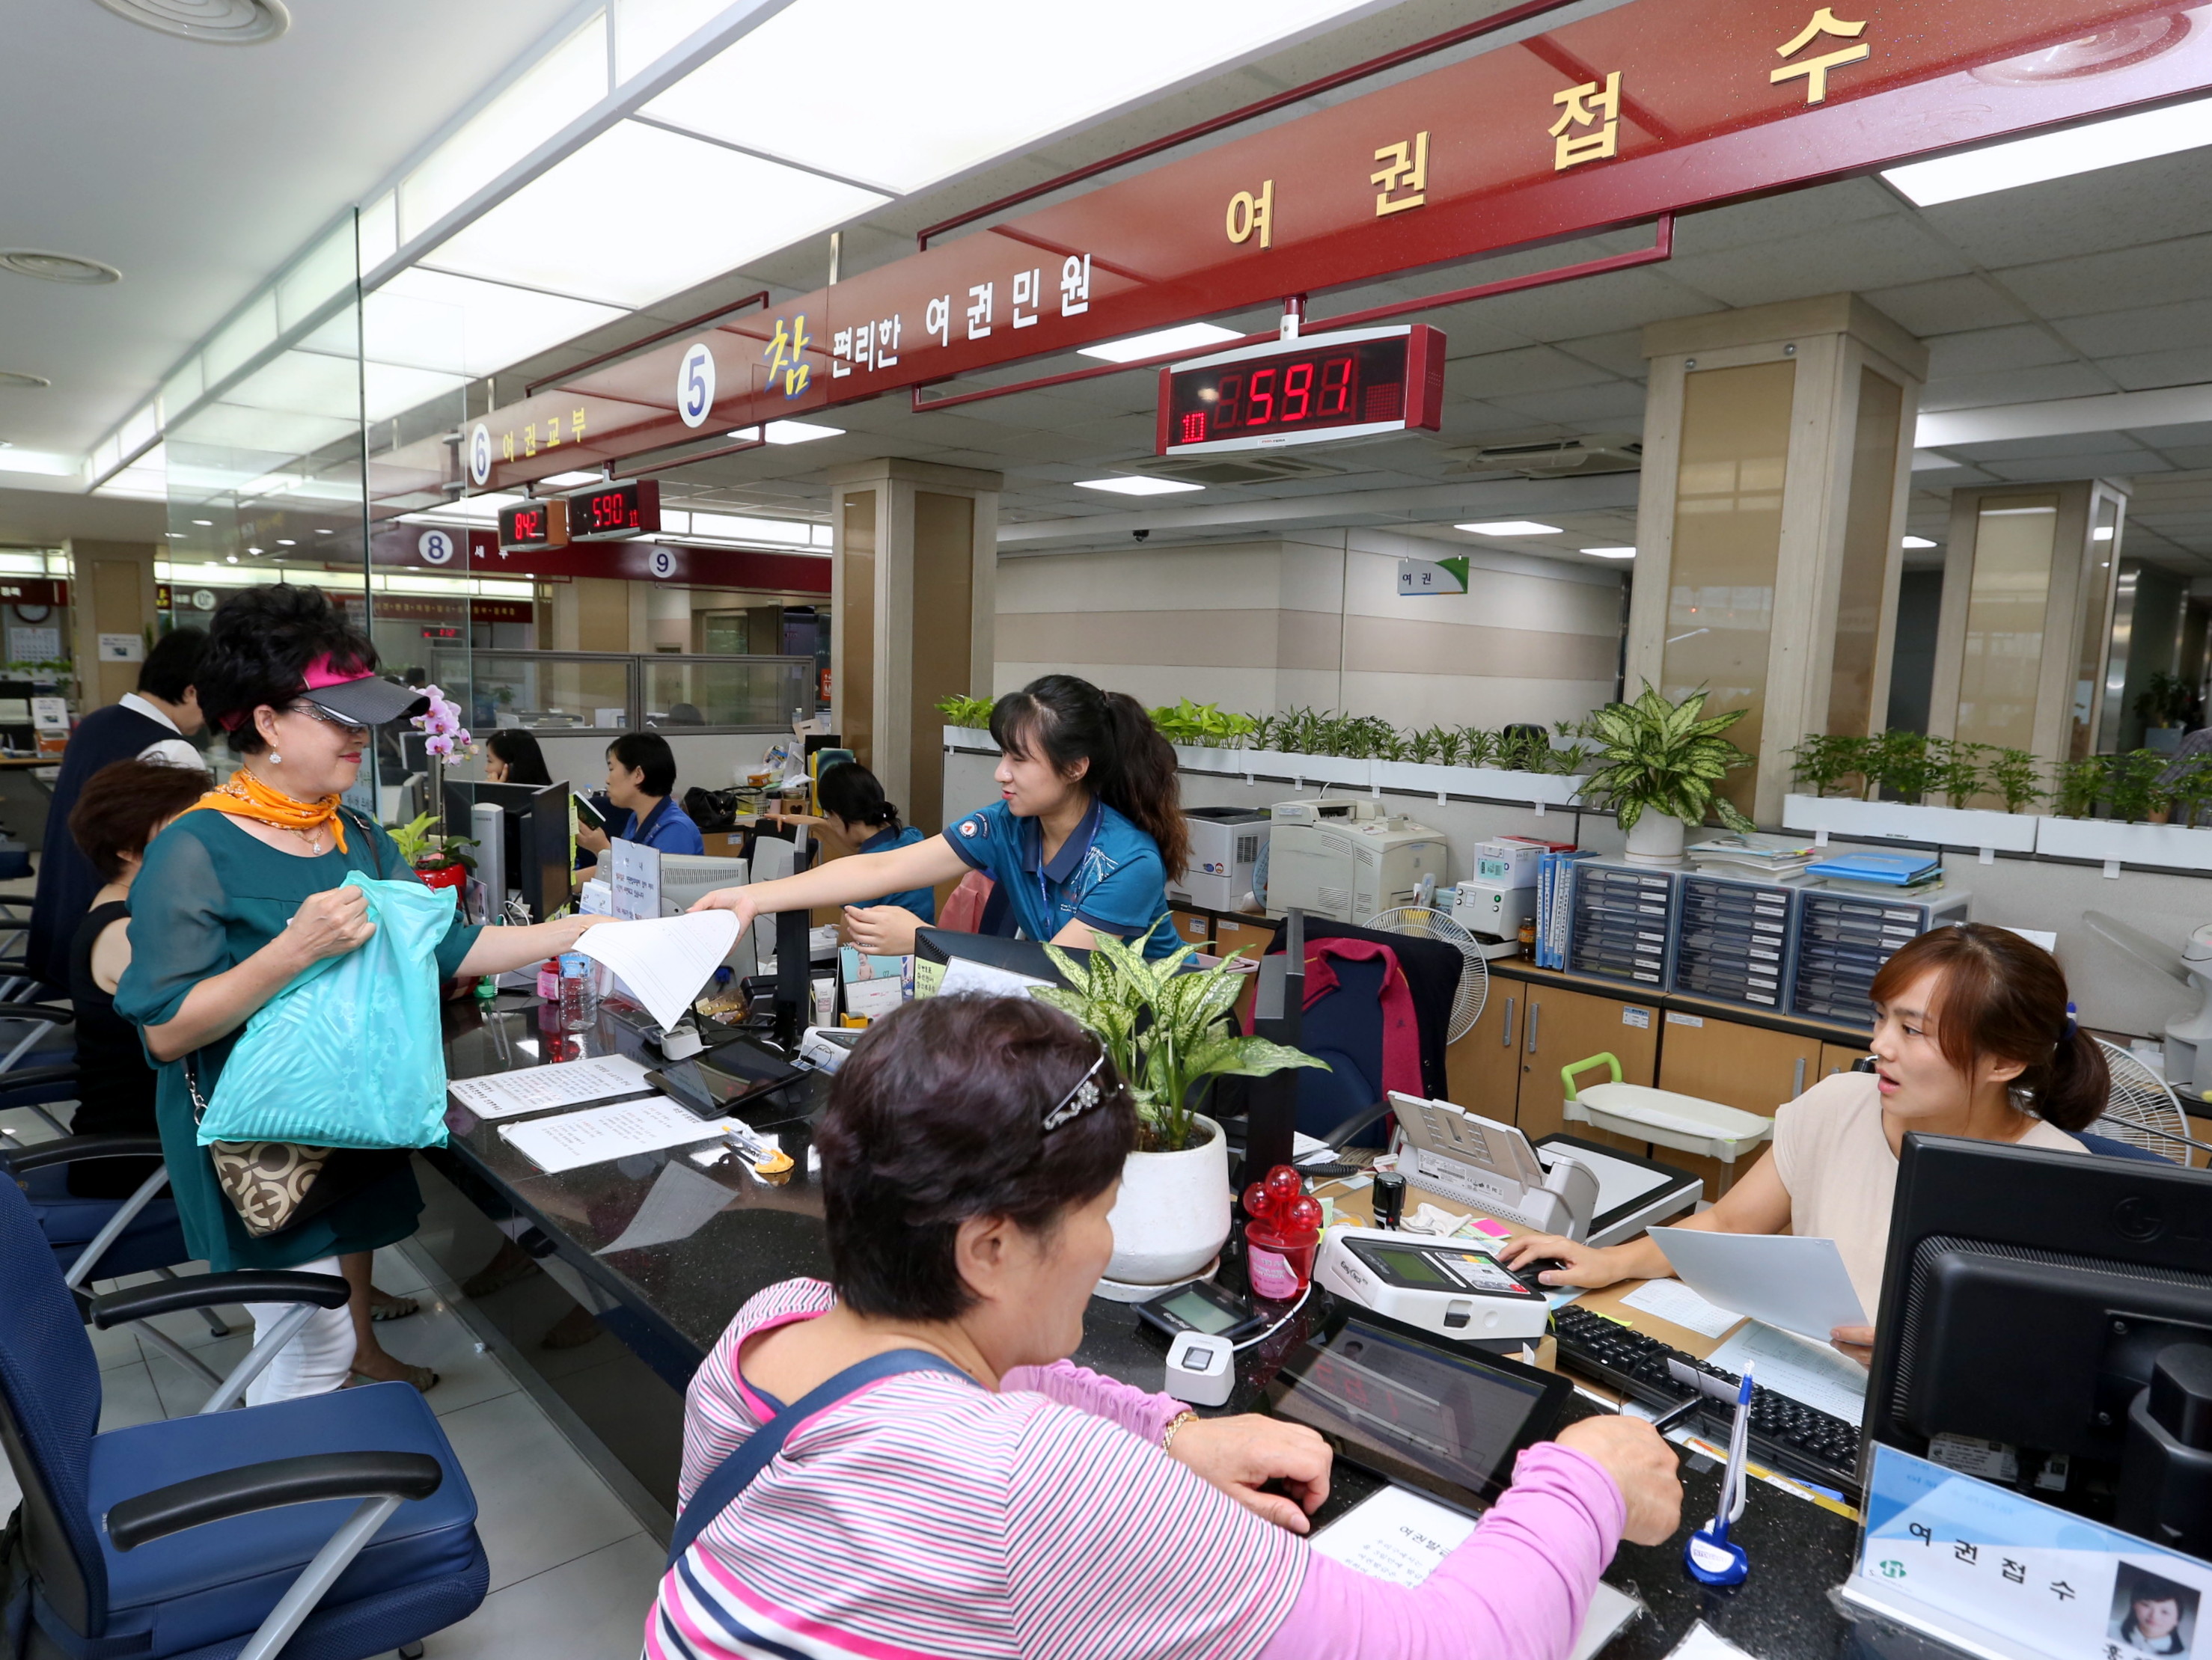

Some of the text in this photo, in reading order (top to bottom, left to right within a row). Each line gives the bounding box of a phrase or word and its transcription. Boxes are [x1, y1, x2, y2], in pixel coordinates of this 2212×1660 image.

[831, 314, 901, 379] 편리한
[687, 353, 706, 417] 5
[1182, 357, 1353, 444] 10 591
[476, 431, 486, 478] 6
[514, 510, 538, 540] 842
[592, 492, 624, 528] 590
[427, 535, 444, 560] 8
[656, 554, 670, 573] 9
